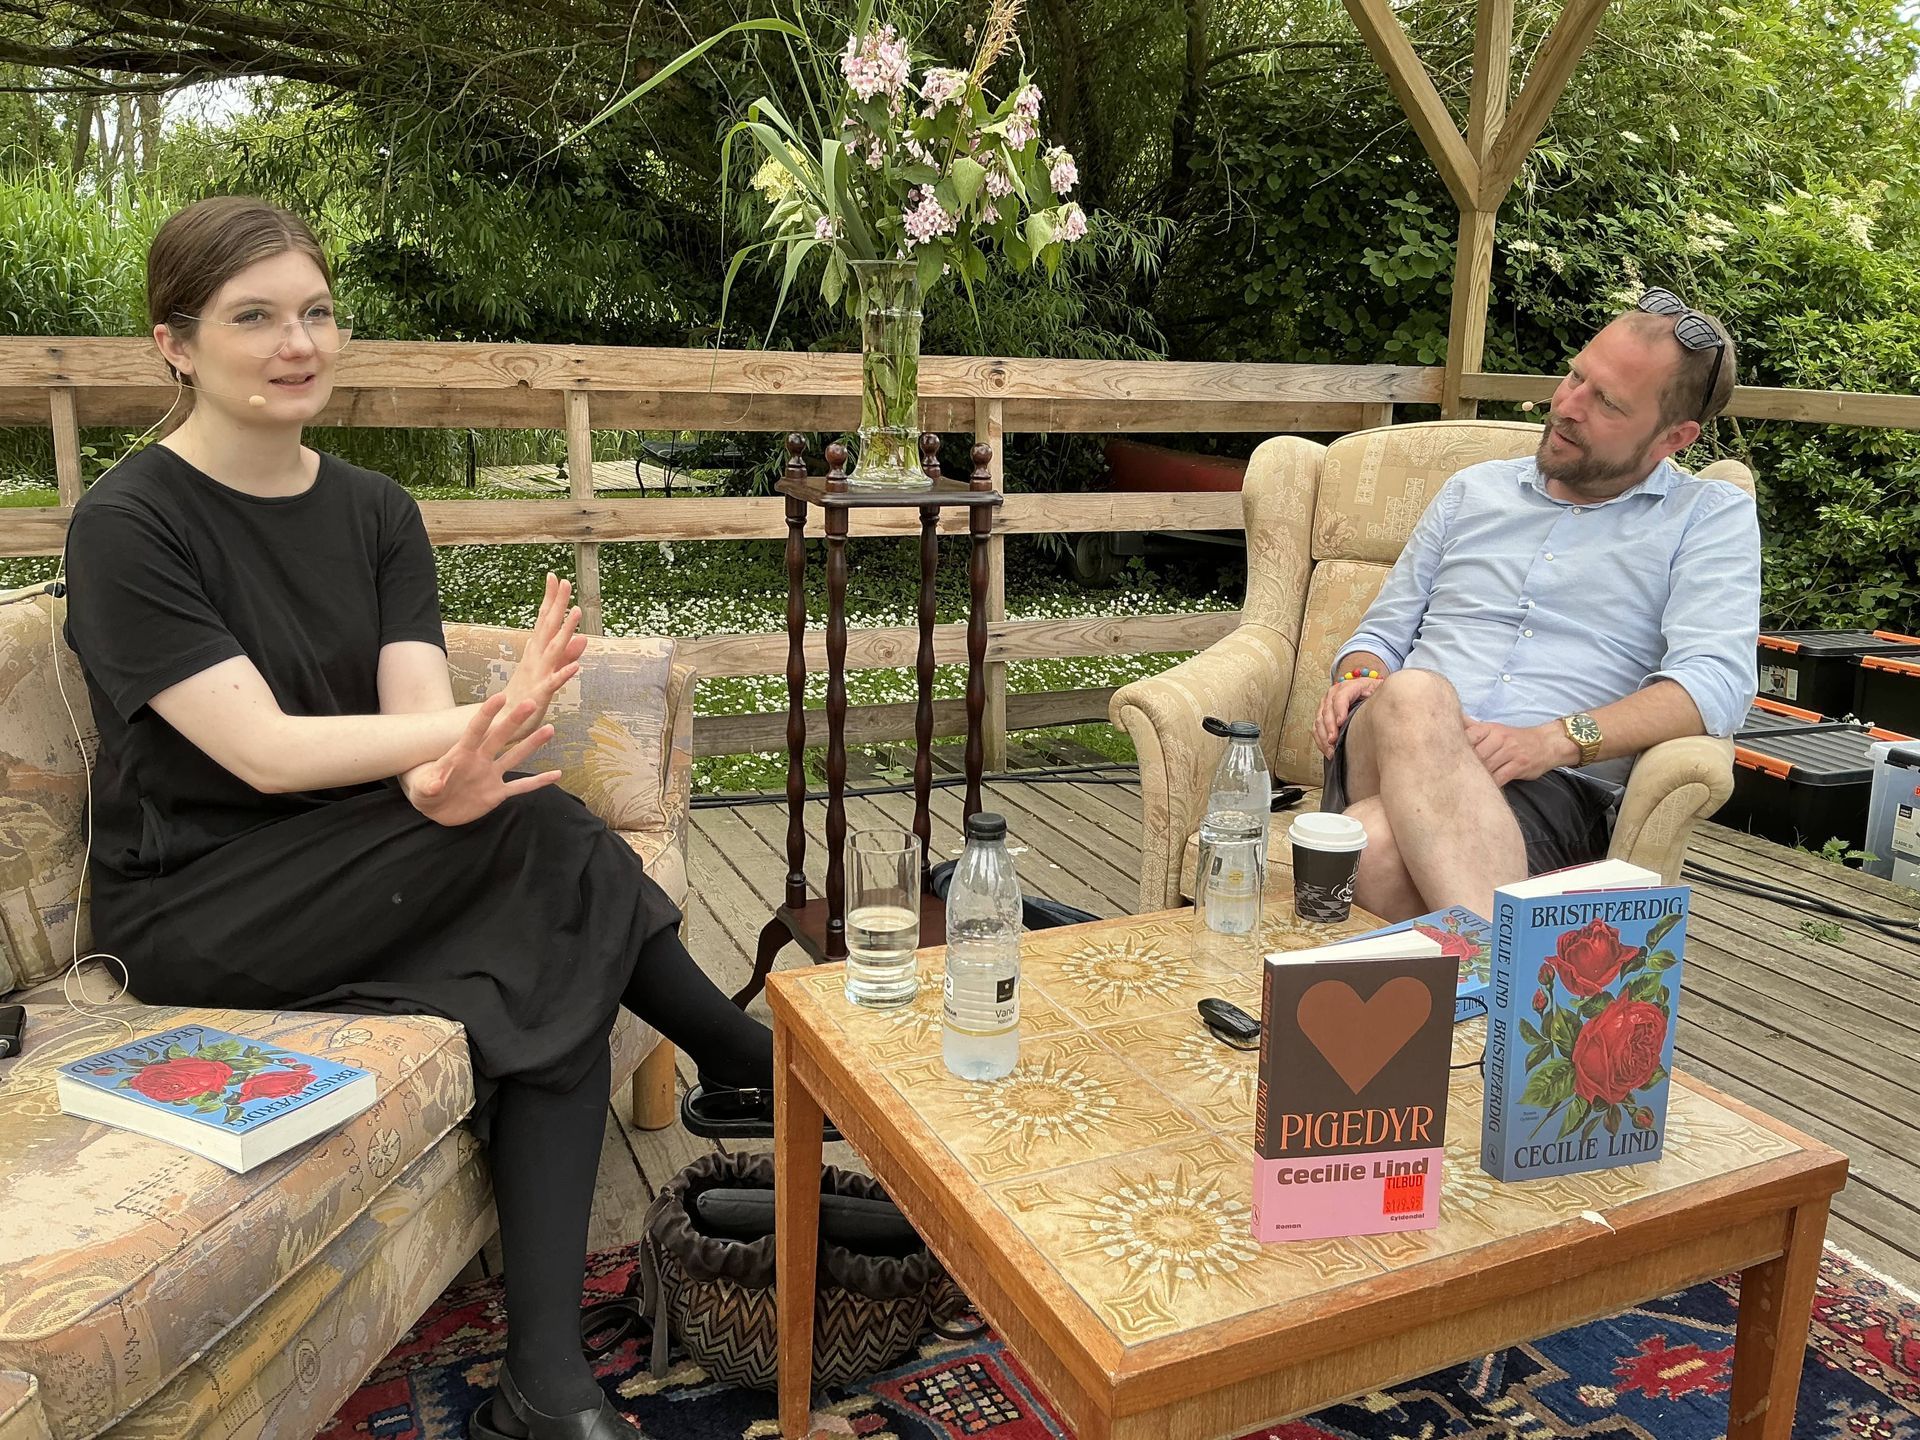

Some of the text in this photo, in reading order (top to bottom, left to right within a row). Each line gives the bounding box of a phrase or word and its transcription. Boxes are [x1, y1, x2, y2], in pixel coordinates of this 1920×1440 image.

[1448, 909, 1491, 933] LIND
[1531, 897, 1684, 928] BRISTEFÆRDIG
[996, 1005, 1015, 1018] Vand
[1488, 903, 1514, 1132] CECILIE LIND BRISTEFÆRDIG
[71, 1027, 204, 1073] CECILIE LIND
[1257, 972, 1273, 1148] Cecilie Lind PIGEDYR
[1280, 1105, 1434, 1150] PIGEDYR
[1514, 1129, 1659, 1169] CECILIE LIND
[1277, 1157, 1429, 1185] Cecilie Lind
[1386, 1174, 1423, 1189] TILBUD
